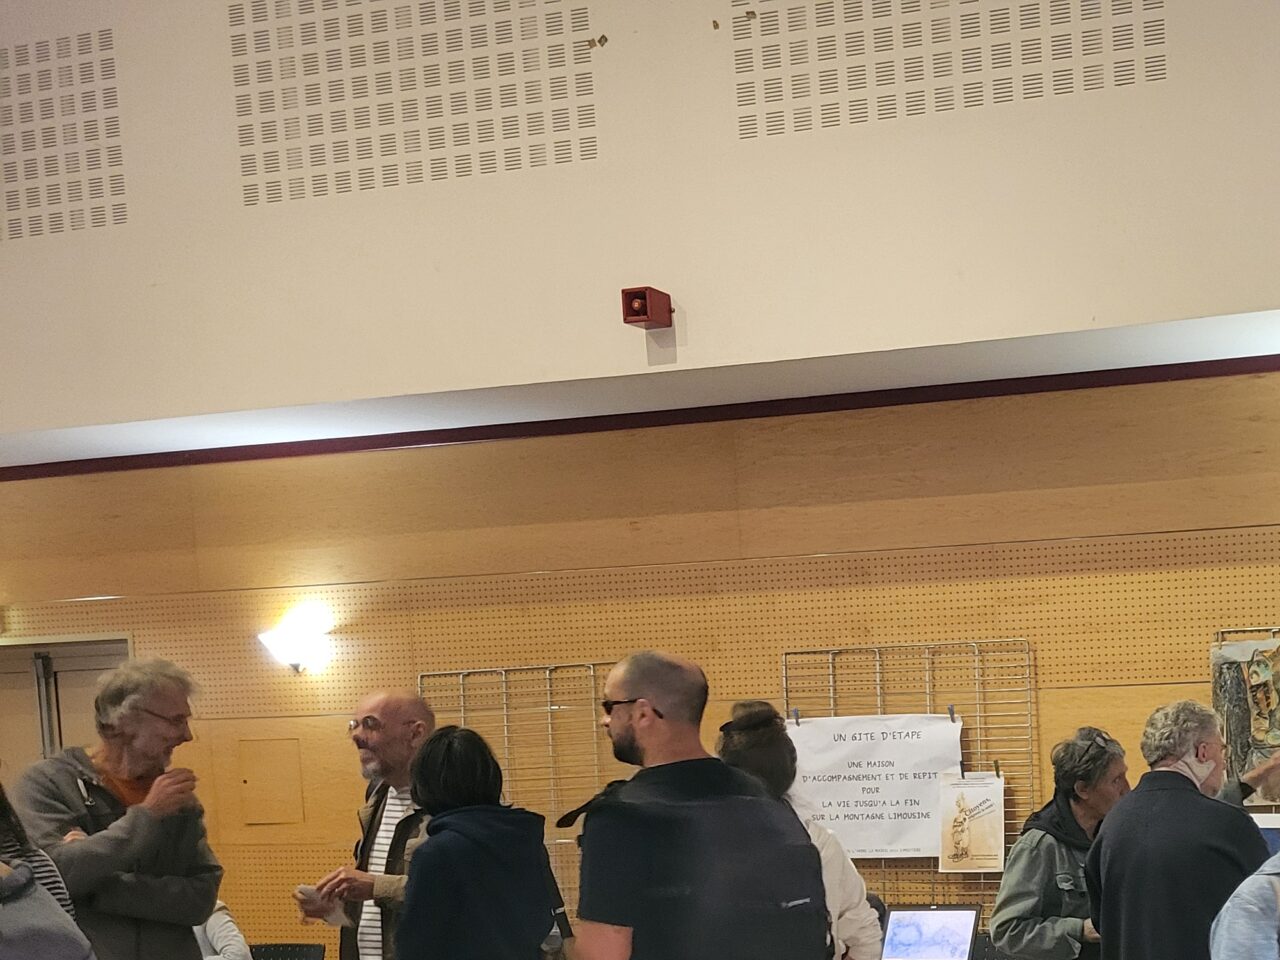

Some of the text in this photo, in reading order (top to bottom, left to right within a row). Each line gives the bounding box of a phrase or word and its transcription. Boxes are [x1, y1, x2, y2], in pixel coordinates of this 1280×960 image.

[833, 731, 922, 742] UN GITE D'ETAPE
[847, 760, 895, 769] UNE MAISON
[802, 773, 882, 783] D'ACCOMPAGNEMENT
[885, 773, 895, 781] ET
[913, 772, 938, 780] REPIT
[888, 812, 931, 820] LIMOUSINE
